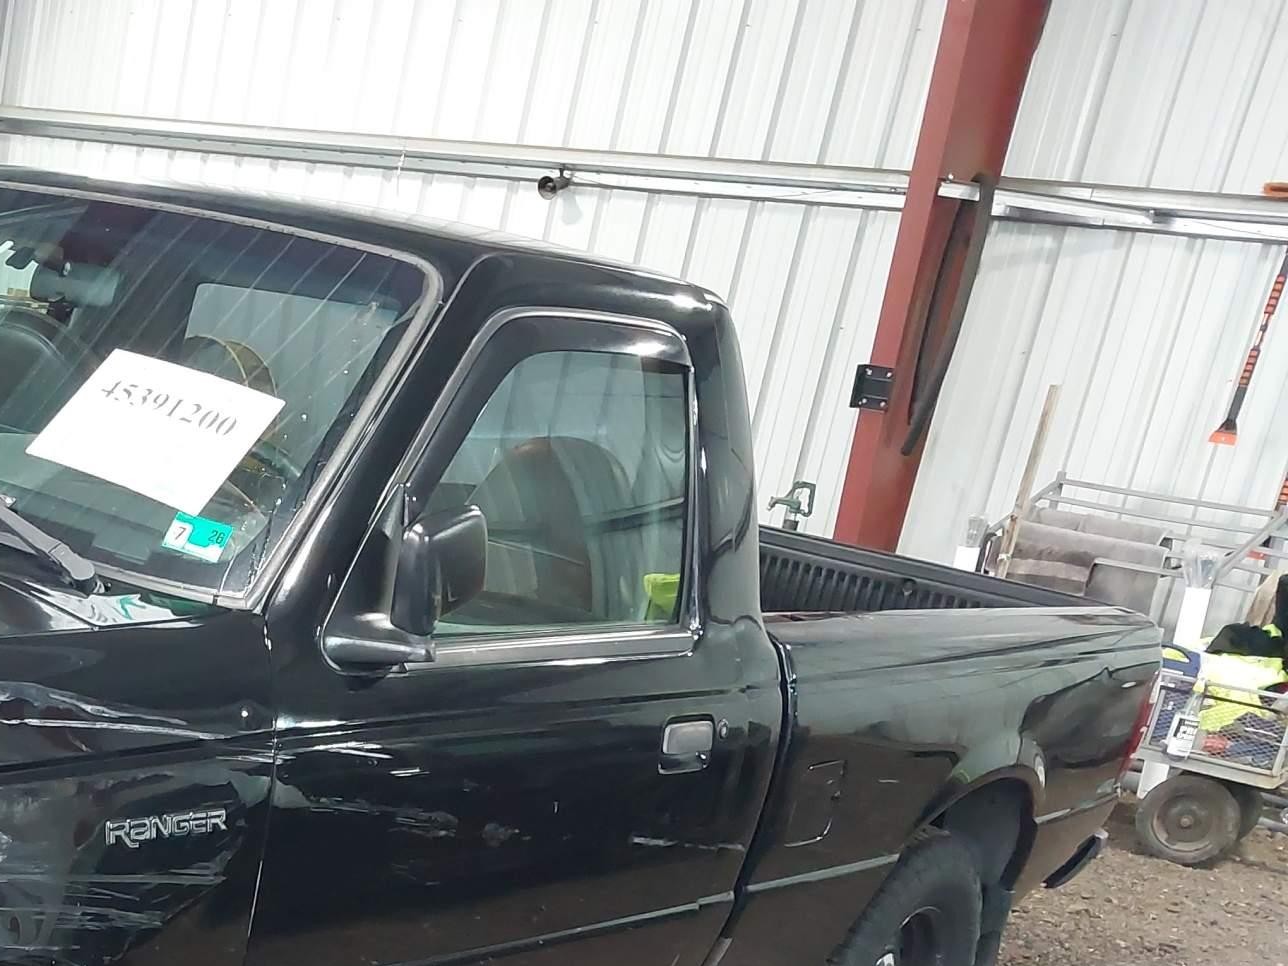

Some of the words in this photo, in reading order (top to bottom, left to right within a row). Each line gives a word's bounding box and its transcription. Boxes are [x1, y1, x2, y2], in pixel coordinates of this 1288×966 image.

[101, 380, 237, 435] 45391200
[175, 526, 186, 540] 7
[207, 529, 226, 545] 26
[105, 808, 229, 848] RANGER
